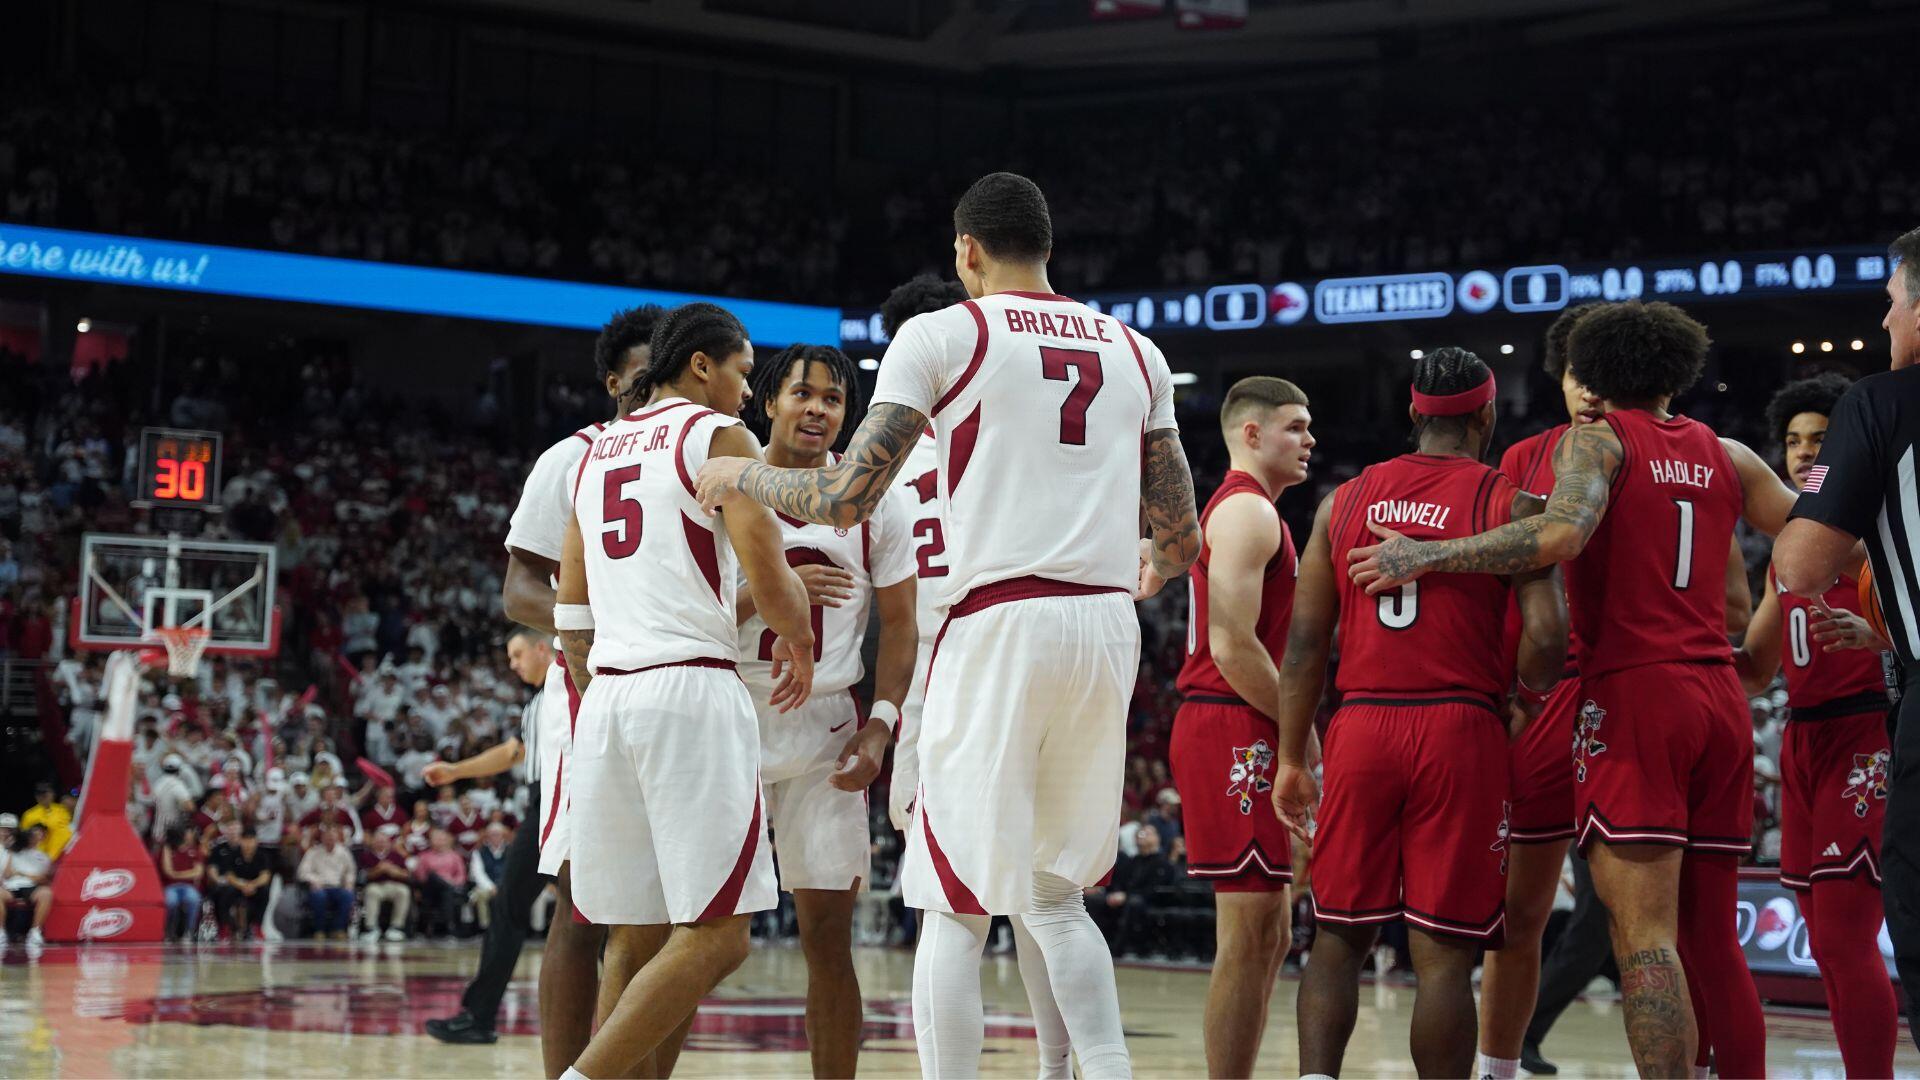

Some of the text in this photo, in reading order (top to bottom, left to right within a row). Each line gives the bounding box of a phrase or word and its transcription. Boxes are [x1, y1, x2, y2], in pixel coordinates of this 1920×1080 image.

[69, 245, 148, 279] with
[151, 254, 209, 285] us!
[1602, 266, 1643, 300] 0.0
[1701, 260, 1742, 295] 0.0
[1792, 254, 1835, 289] 0.0
[1226, 290, 1244, 322] 0
[1324, 282, 1446, 315] TEAM STATS
[1528, 273, 1547, 305] 0
[1004, 308, 1113, 344] BRAZILE
[1136, 297, 1155, 329] 0
[1183, 294, 1200, 326] 0
[1038, 345, 1104, 446] 7
[591, 424, 670, 462] ACUFF JR.
[154, 458, 205, 500] 30
[1649, 459, 1714, 489] HADLEY
[601, 463, 644, 561] 5
[912, 517, 950, 579] 2
[1673, 499, 1694, 589] 1
[1789, 605, 1811, 668] 0
